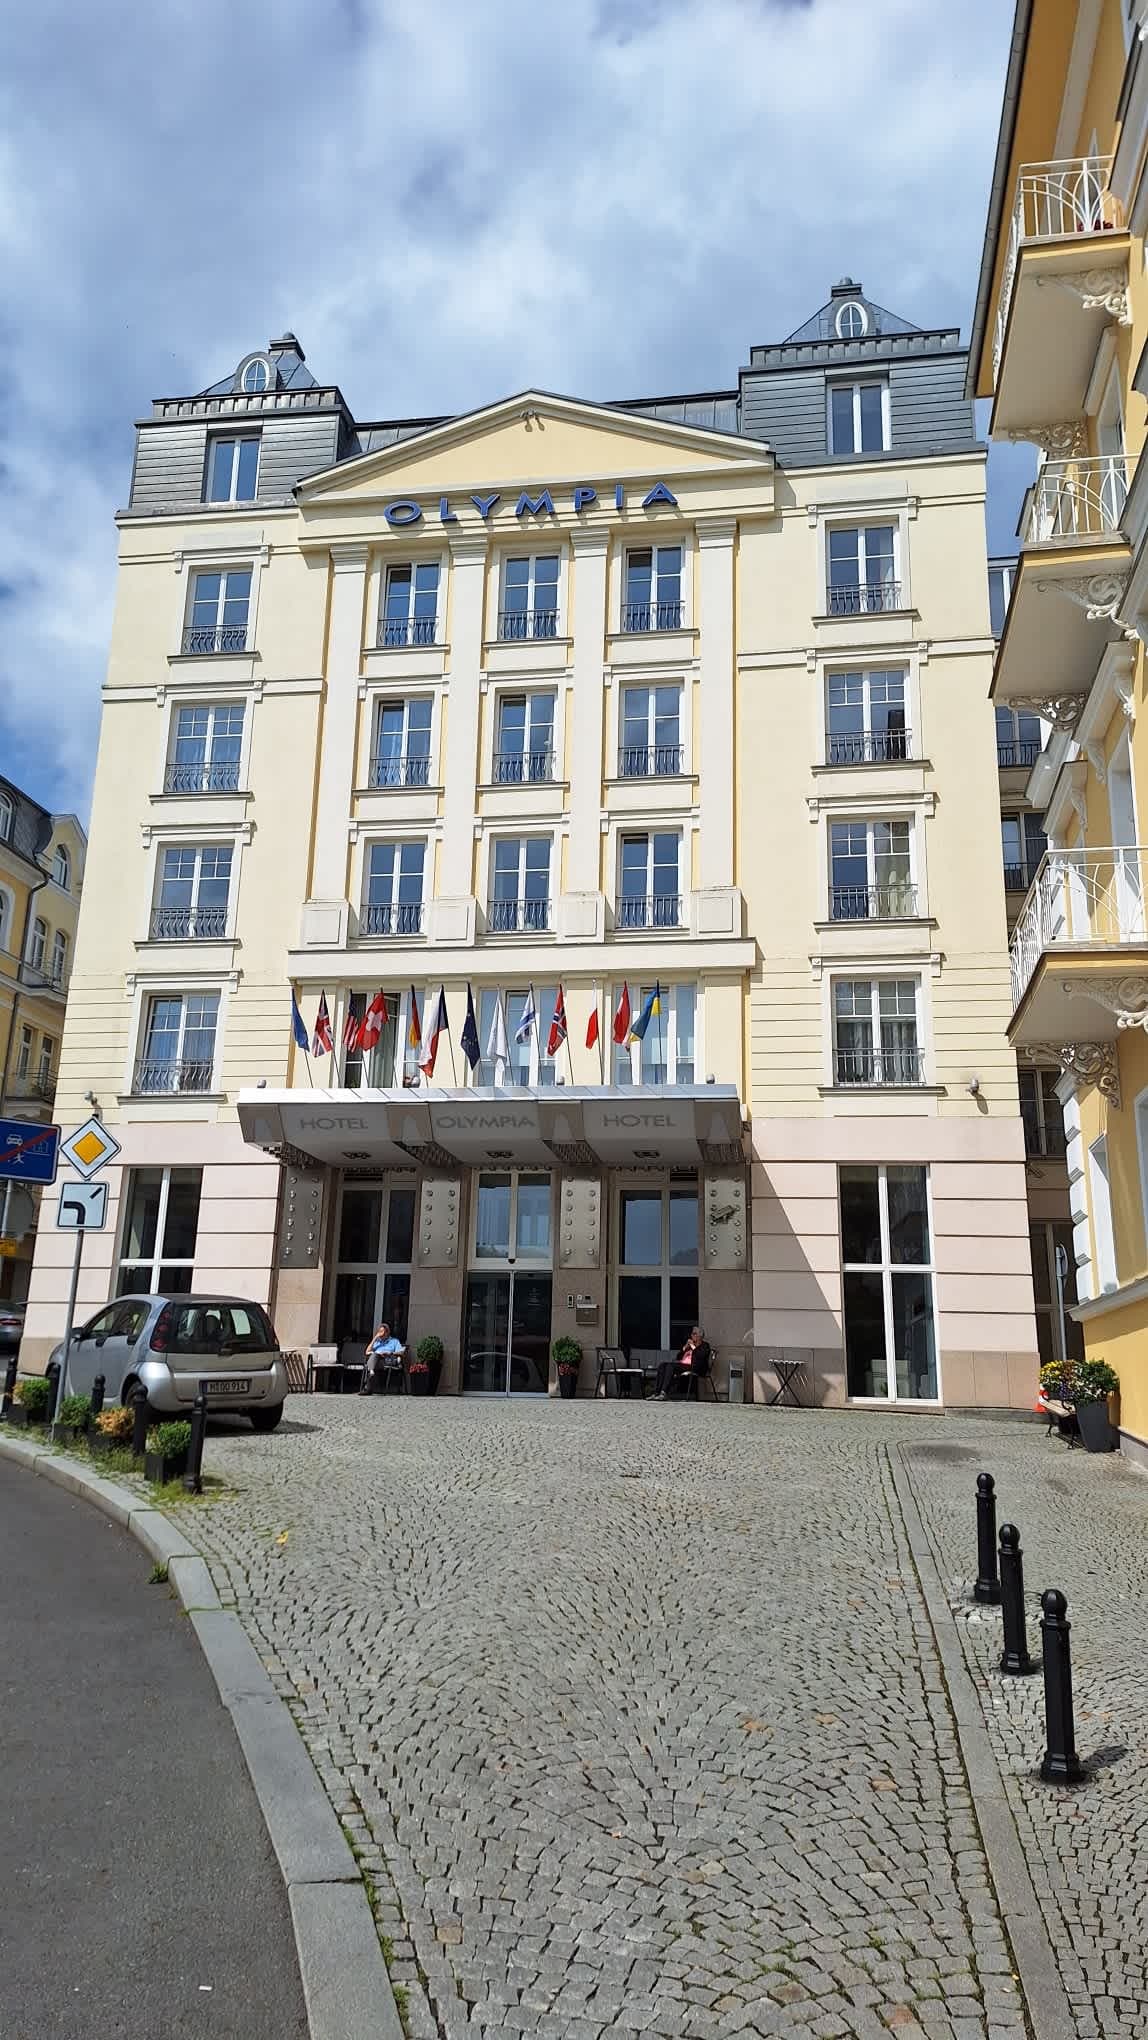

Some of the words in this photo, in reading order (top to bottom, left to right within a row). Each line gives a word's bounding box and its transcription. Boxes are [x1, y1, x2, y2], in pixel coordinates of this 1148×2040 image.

[383, 481, 678, 525] OLYMPIA
[300, 1118, 369, 1129] HOTEL
[435, 1116, 536, 1129] OLYMPIA
[603, 1114, 678, 1127] HOTEL
